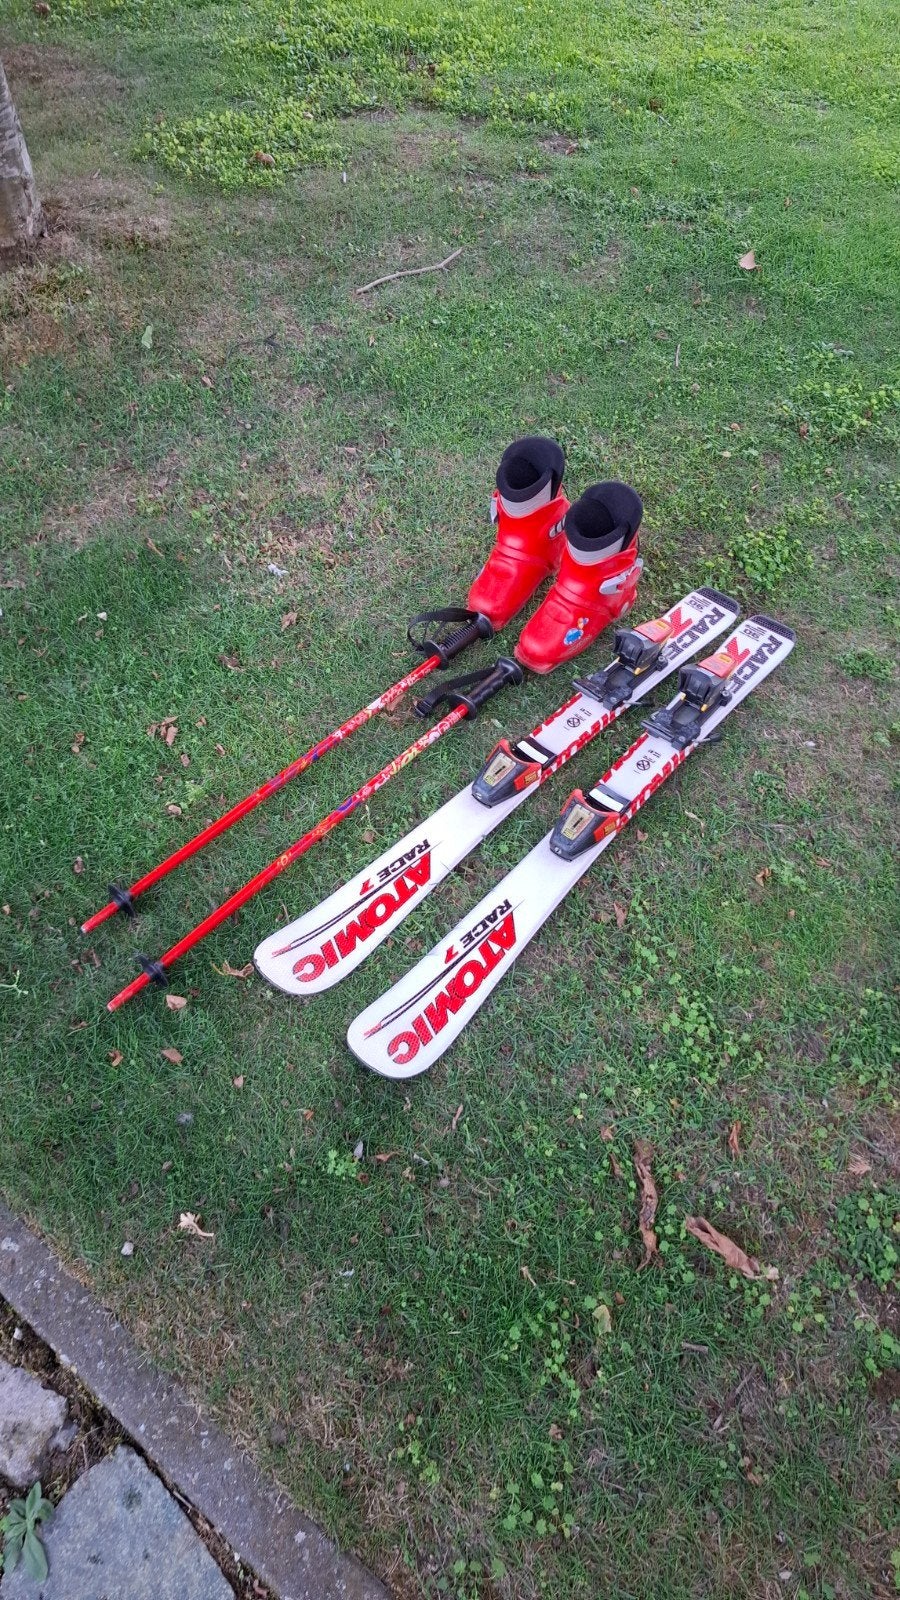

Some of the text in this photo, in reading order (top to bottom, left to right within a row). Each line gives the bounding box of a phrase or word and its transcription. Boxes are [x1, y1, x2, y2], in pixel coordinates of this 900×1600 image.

[666, 607, 726, 661] RACE
[729, 634, 783, 694] RACE
[359, 838, 431, 896] RACE 7
[292, 851, 432, 983] ATOMIC
[444, 899, 512, 964] RACE 7
[387, 911, 518, 1065] ATOMIC
